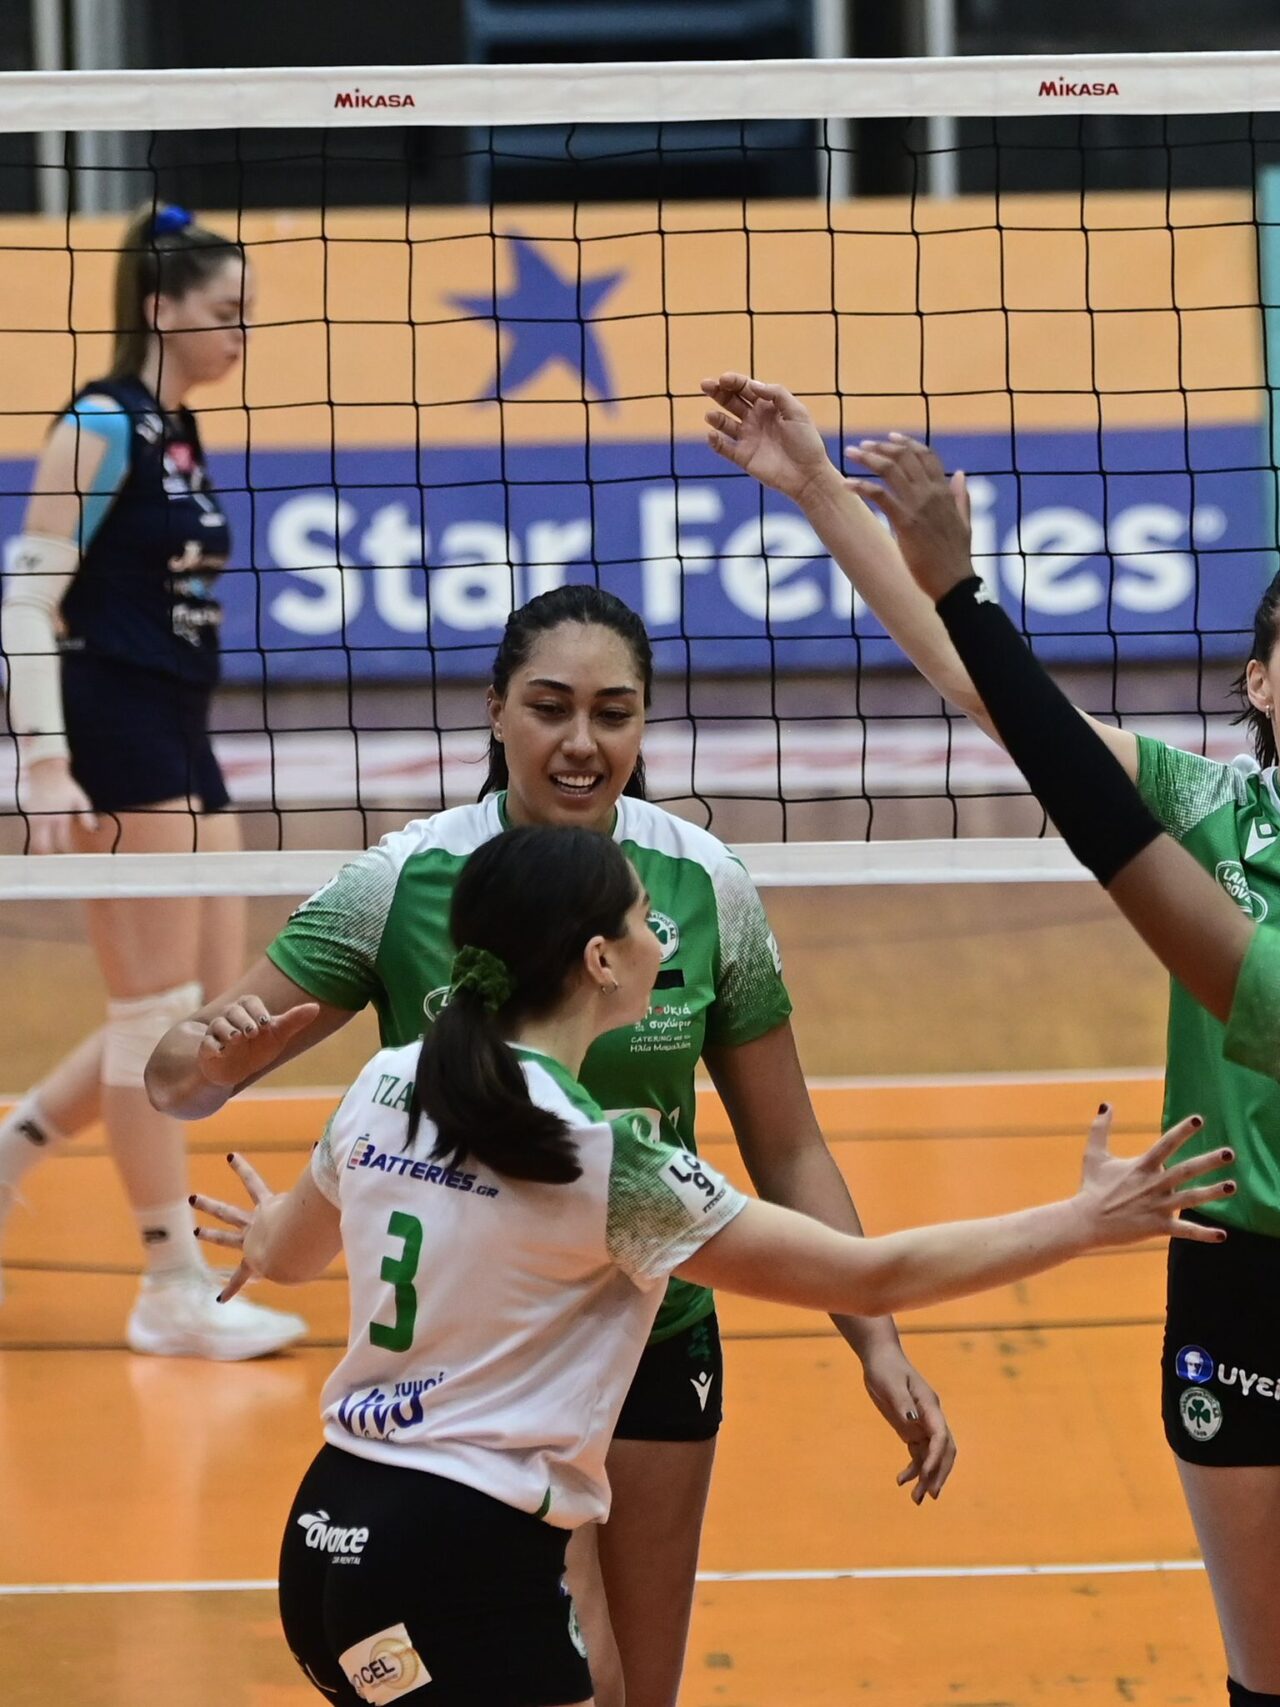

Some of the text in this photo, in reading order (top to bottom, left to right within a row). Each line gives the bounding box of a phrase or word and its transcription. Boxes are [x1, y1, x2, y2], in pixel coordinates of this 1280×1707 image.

[267, 475, 1197, 636] Star Feies
[369, 1210, 424, 1353] 3
